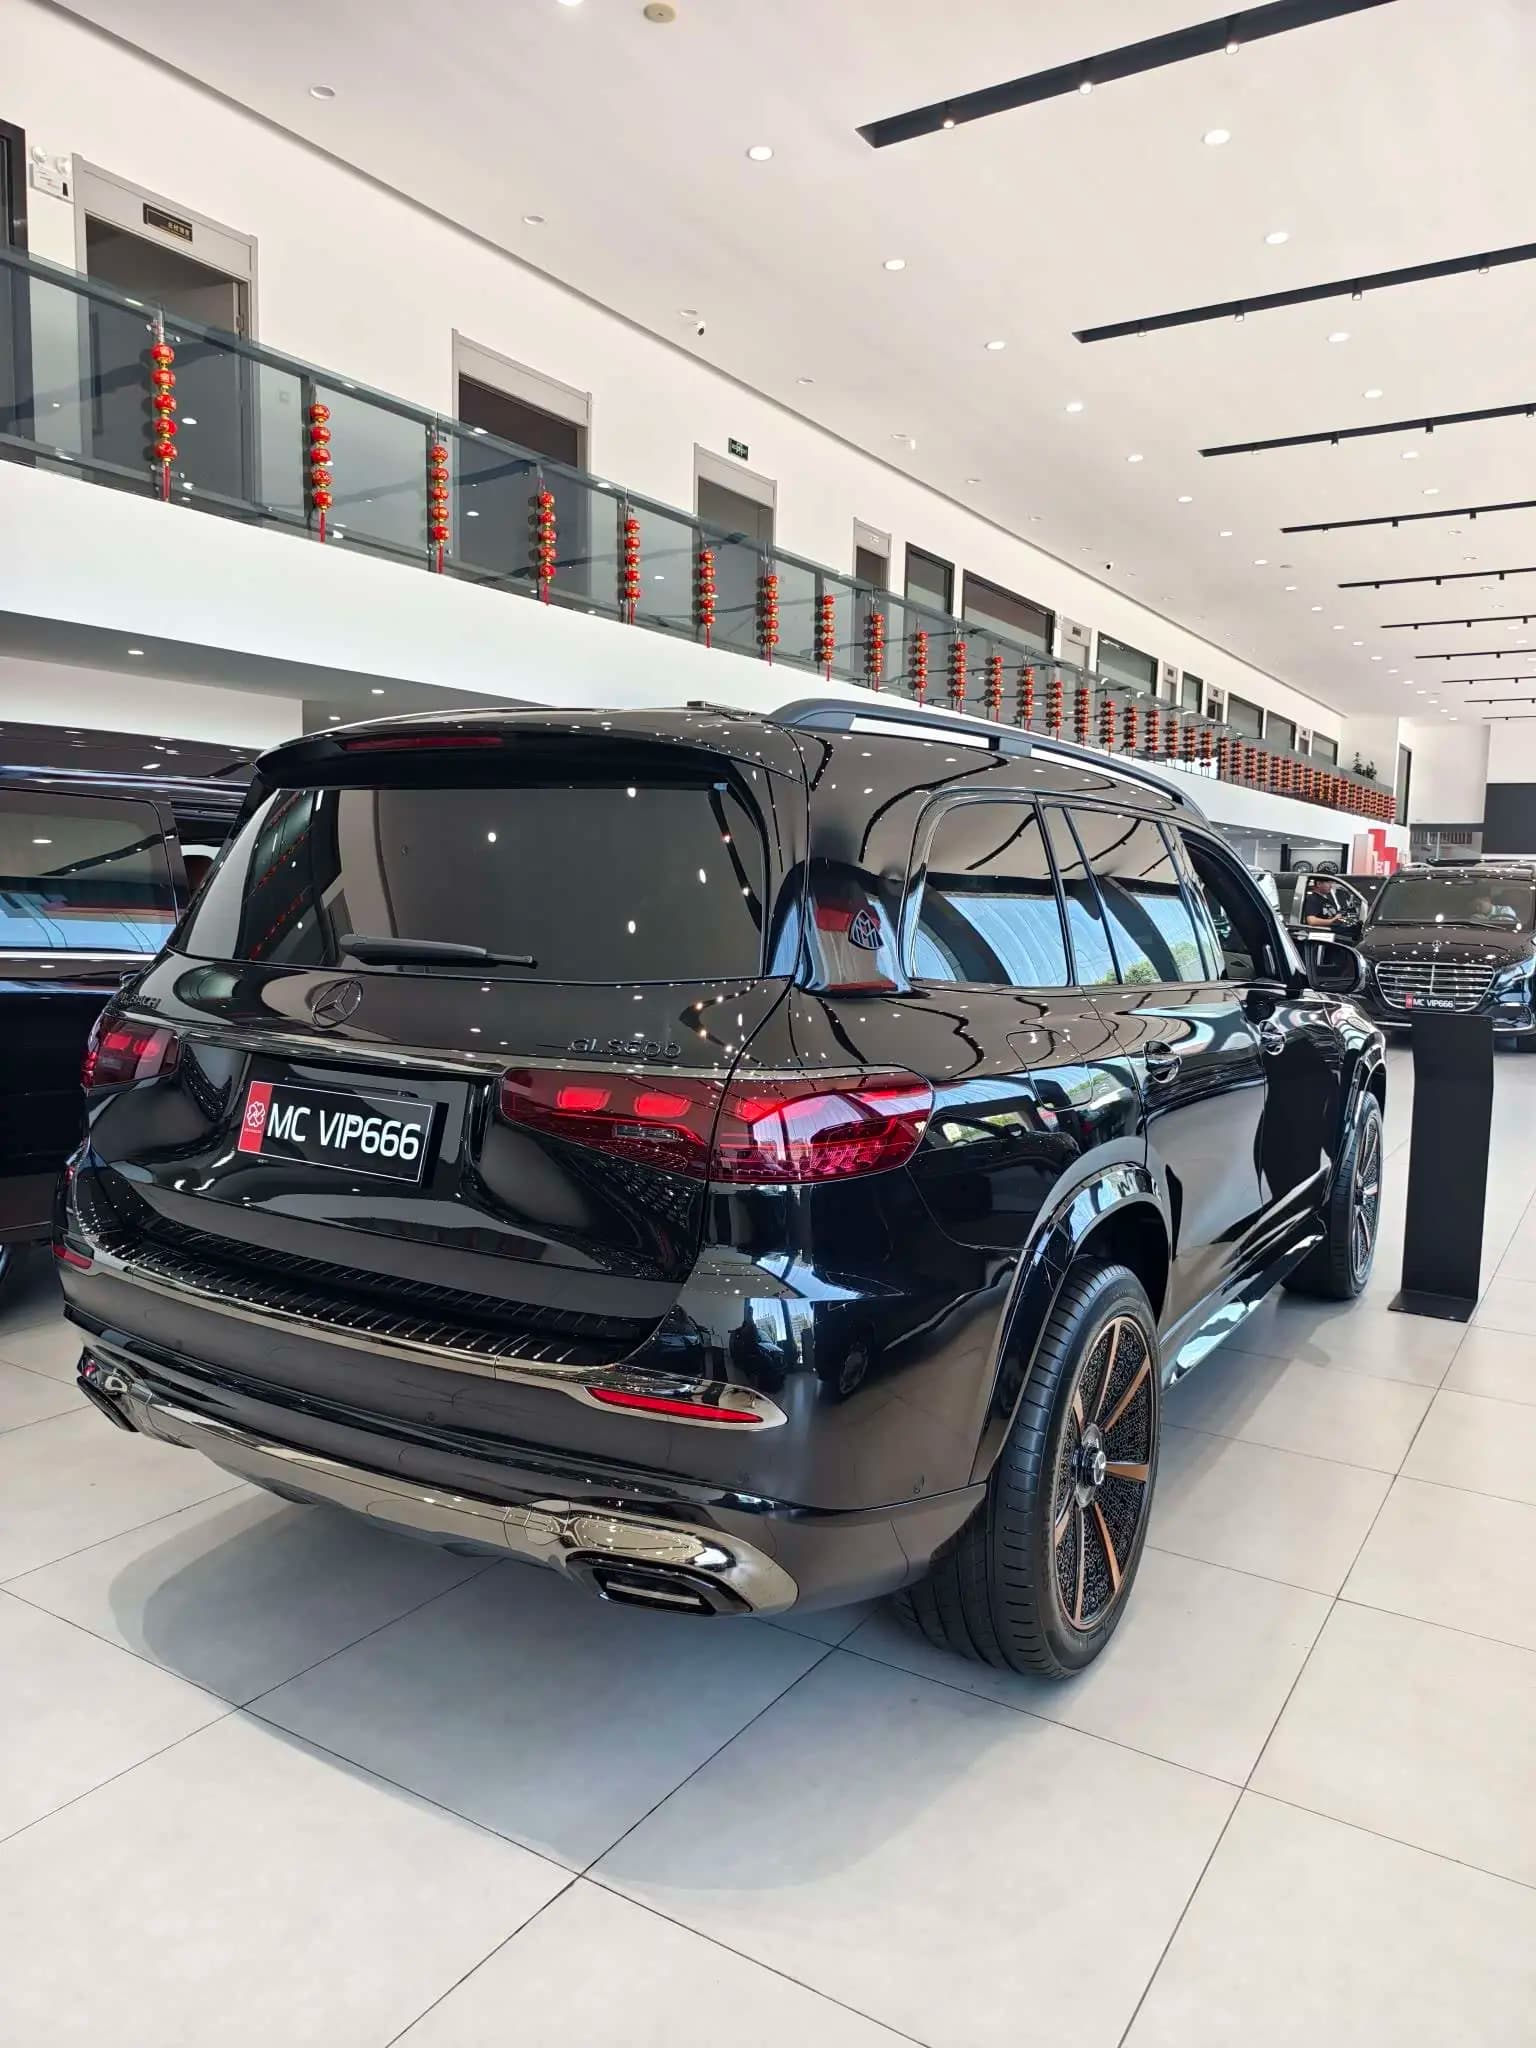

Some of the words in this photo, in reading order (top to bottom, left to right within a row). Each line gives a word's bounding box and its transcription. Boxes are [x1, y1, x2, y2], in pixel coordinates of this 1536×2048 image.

[1412, 998, 1425, 1006] MC
[1426, 999, 1454, 1008] VIP666
[266, 1102, 311, 1142] MC
[319, 1109, 422, 1161] VIP666
